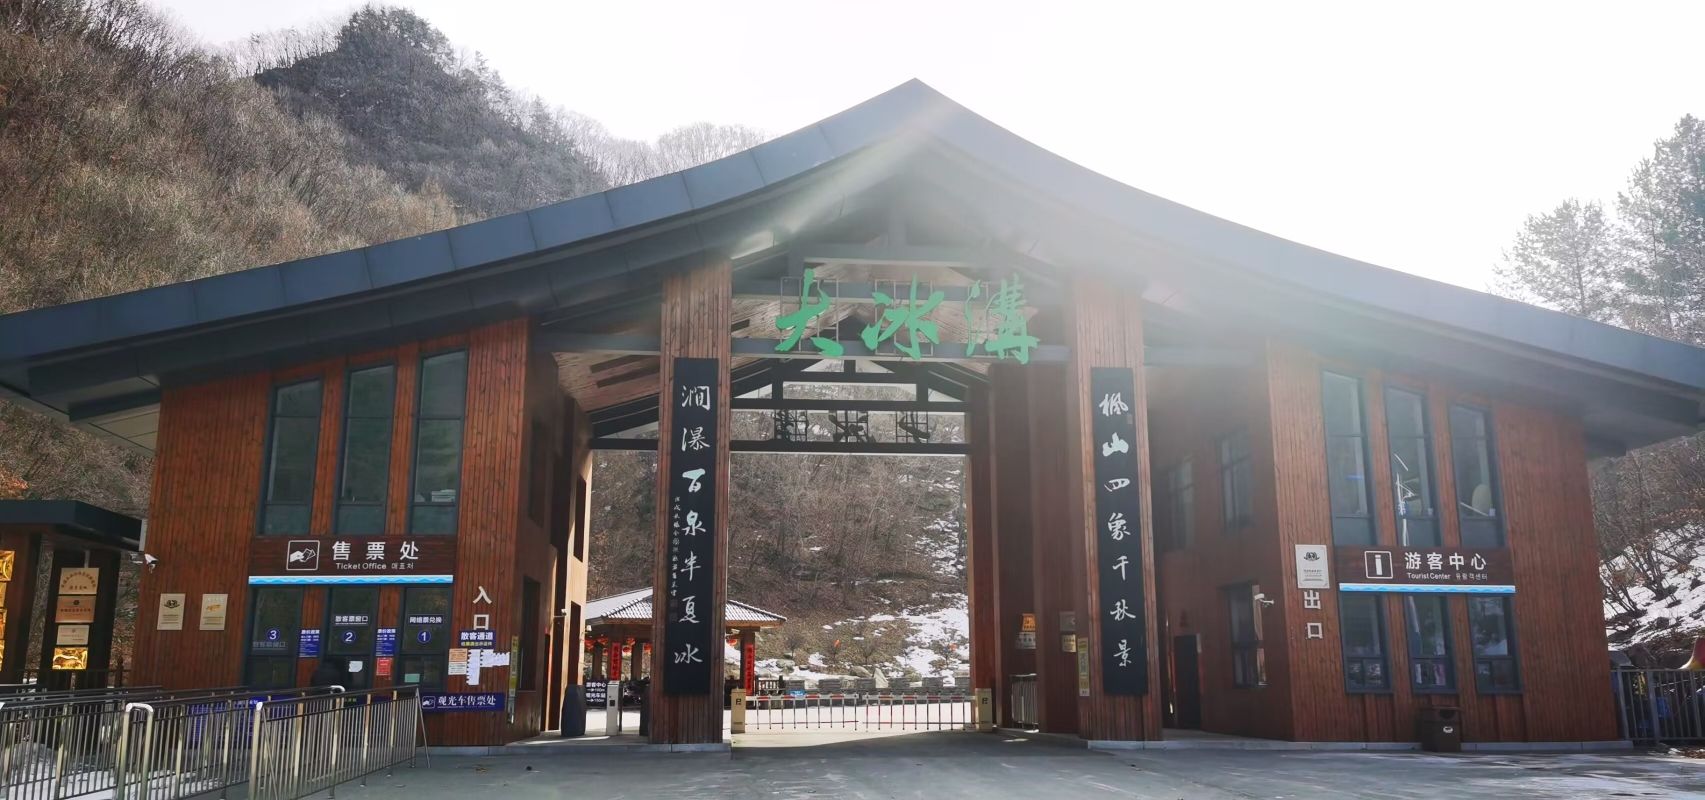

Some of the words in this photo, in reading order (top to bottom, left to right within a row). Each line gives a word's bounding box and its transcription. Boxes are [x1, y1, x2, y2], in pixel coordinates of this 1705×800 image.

[332, 541, 419, 561] 售票处
[336, 562, 361, 570] Ticket
[362, 562, 387, 570] Office
[1404, 552, 1487, 571] 游客中心
[1407, 572, 1429, 580] Tourist
[472, 586, 492, 630] 入口
[1304, 590, 1323, 639] 出口
[269, 629, 277, 640] 3
[345, 631, 354, 642] 2
[461, 631, 493, 640] 散客通道
